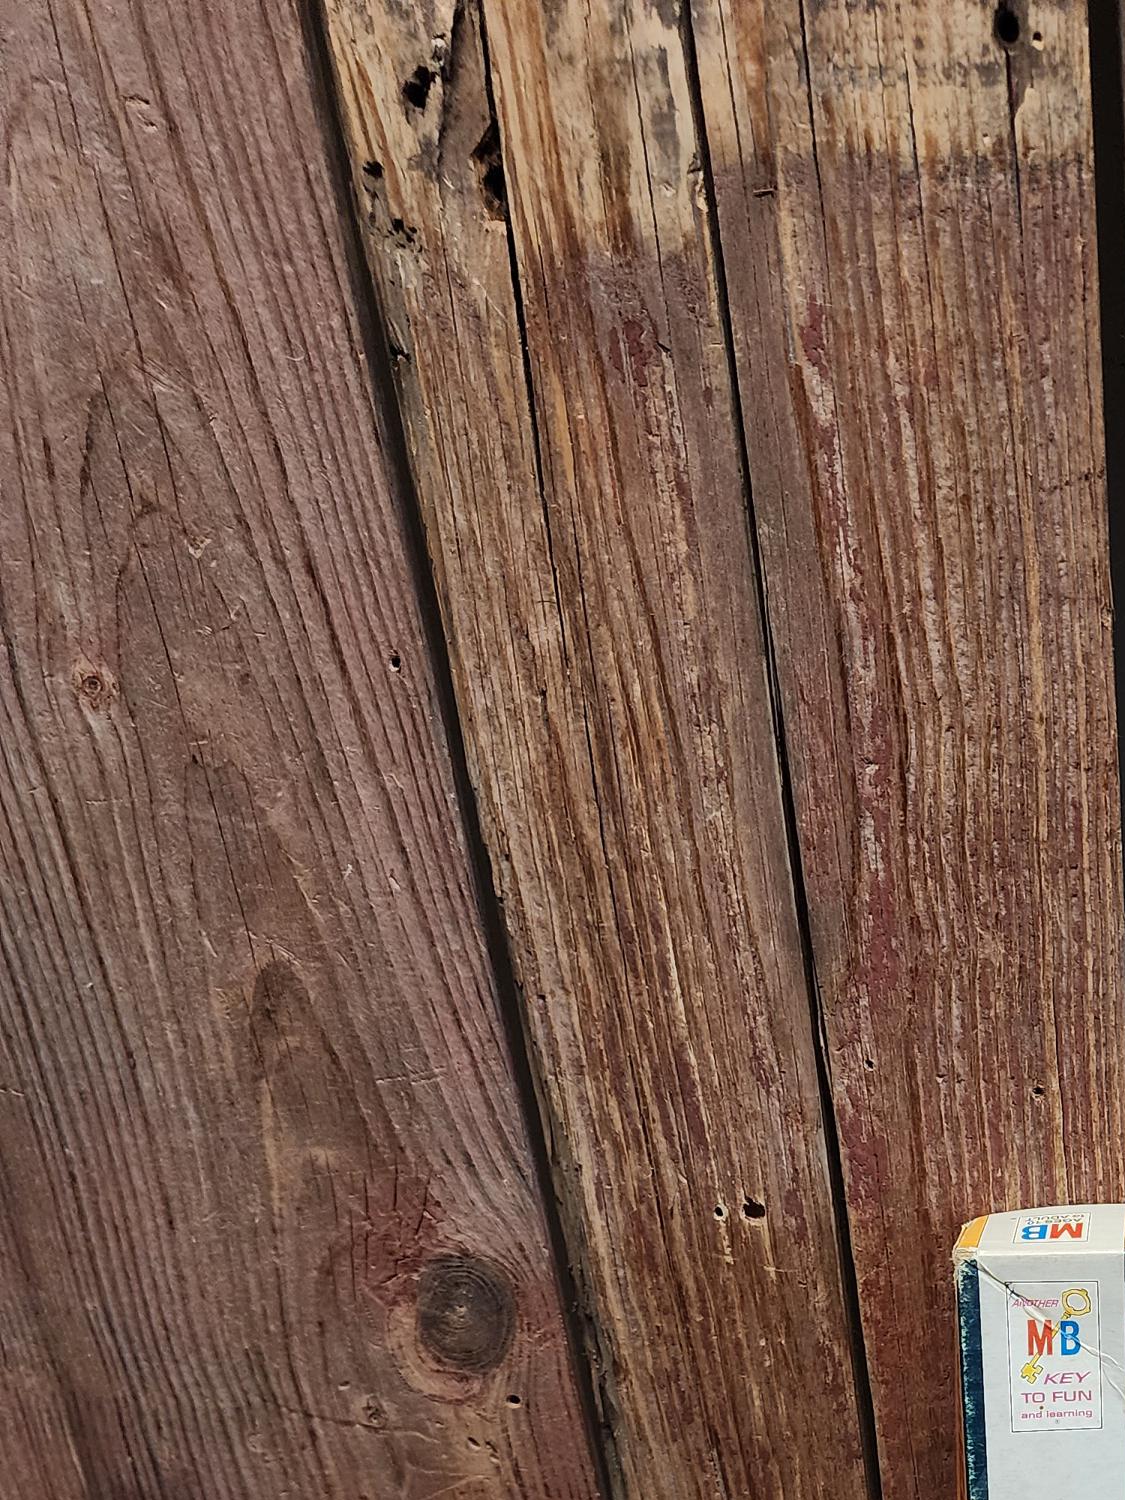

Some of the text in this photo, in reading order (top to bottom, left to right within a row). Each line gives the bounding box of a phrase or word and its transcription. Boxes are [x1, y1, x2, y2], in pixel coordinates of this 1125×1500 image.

[1043, 1371, 1091, 1385] KEY
[1021, 1390, 1092, 1404] TO FUN
[1021, 1410, 1093, 1419] and learning
